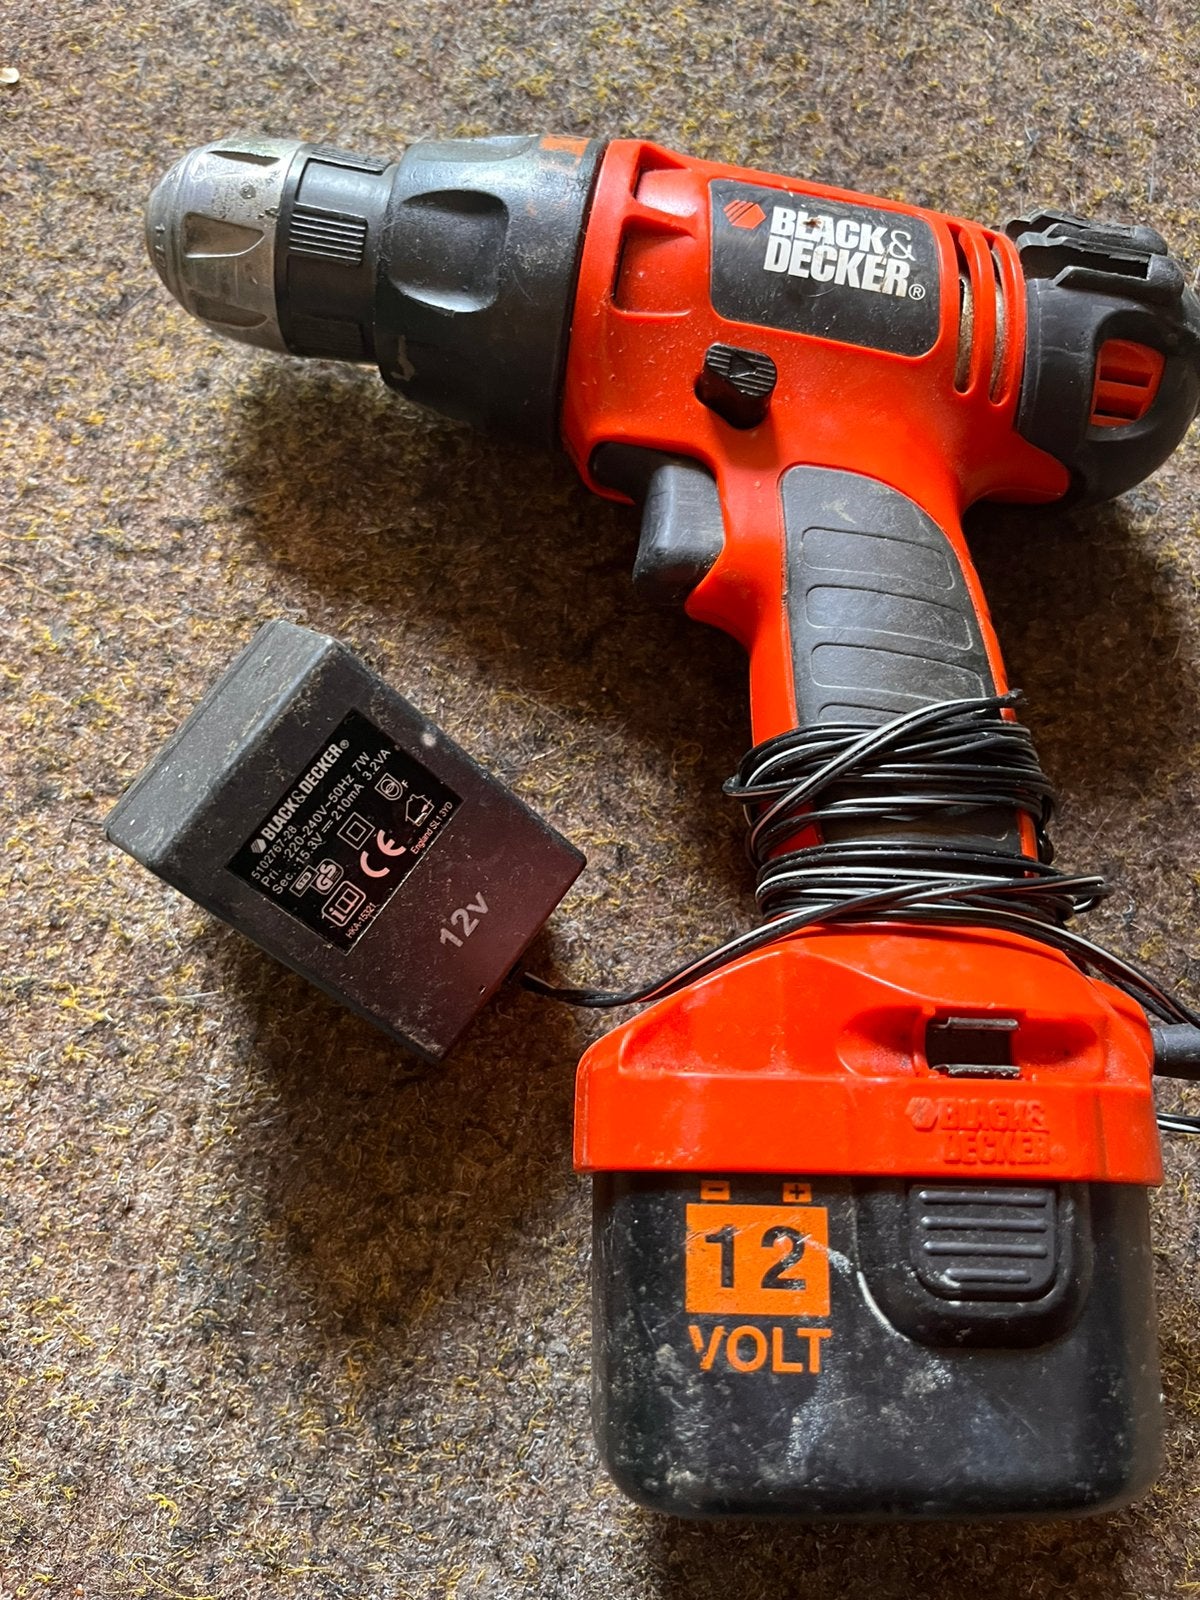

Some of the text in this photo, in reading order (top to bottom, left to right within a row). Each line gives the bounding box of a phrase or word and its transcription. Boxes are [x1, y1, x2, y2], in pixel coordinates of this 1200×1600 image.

[770, 206, 916, 261] BLACK&
[330, 781, 365, 821] 210mA
[361, 747, 391, 782] 3.2VA
[260, 868, 282, 888] Pri.
[352, 751, 372, 773] 7W
[410, 827, 435, 855] England
[250, 824, 298, 881] 5102767-28
[315, 859, 338, 893] GS
[360, 828, 407, 878] CE
[440, 892, 489, 948] 12v
[689, 1325, 830, 1373] VOLT
